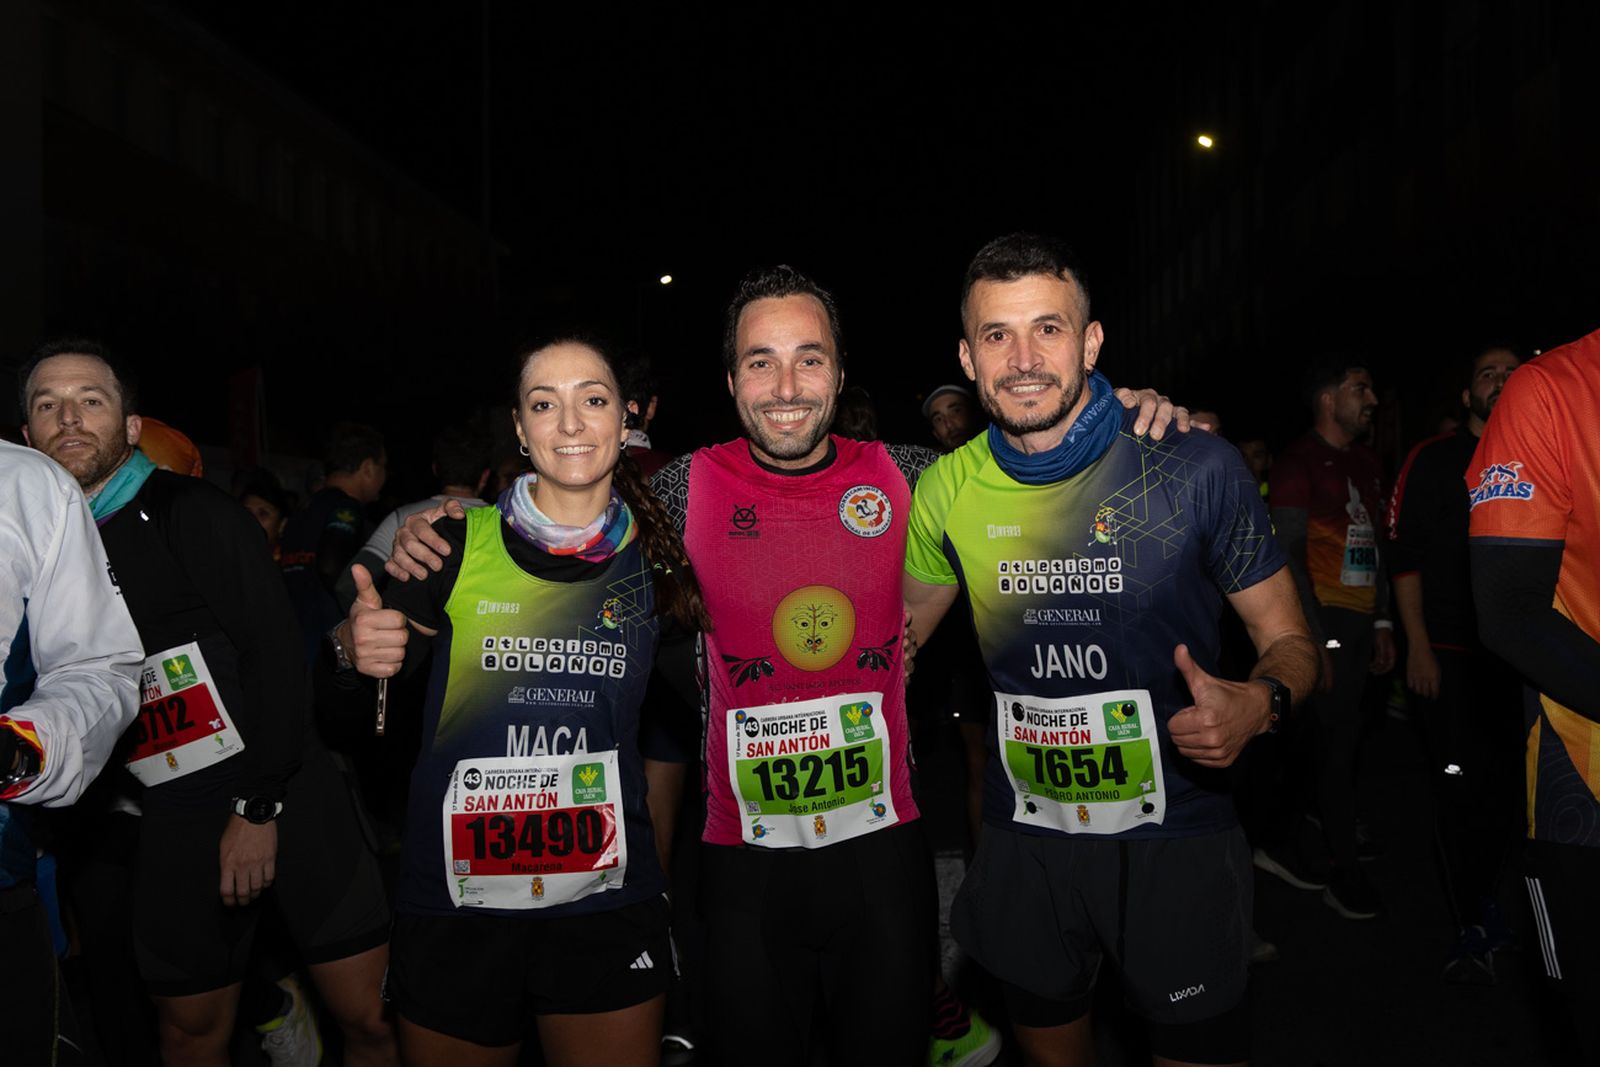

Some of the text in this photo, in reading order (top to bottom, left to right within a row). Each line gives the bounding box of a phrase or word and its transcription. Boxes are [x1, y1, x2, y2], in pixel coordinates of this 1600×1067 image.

[998, 574, 1123, 594] BOLAÑOS
[1038, 609, 1101, 621] GENERALI
[482, 652, 626, 679] BOLAÑOS
[1031, 643, 1108, 680] JANO
[526, 688, 596, 703] GENERALI
[745, 721, 759, 732] 43
[762, 715, 828, 737] NOCHE DE
[1027, 712, 1088, 727] NOCHE DE
[506, 725, 589, 758] MACA
[746, 732, 830, 758] SAN ANTÓN
[1014, 726, 1091, 745] SAN ANTÓN
[752, 745, 869, 801] 13215
[1026, 745, 1129, 789] 7654
[464, 772, 481, 784] 43
[485, 774, 559, 790] NOCHE DE
[464, 789, 559, 812] SAN ANTÓN
[1075, 789, 1120, 801] ANTONIO
[789, 796, 846, 814] Jose Antonio
[466, 809, 603, 860] 13490
[511, 862, 563, 873] Macarena
[1169, 984, 1206, 1002] LIXADA
